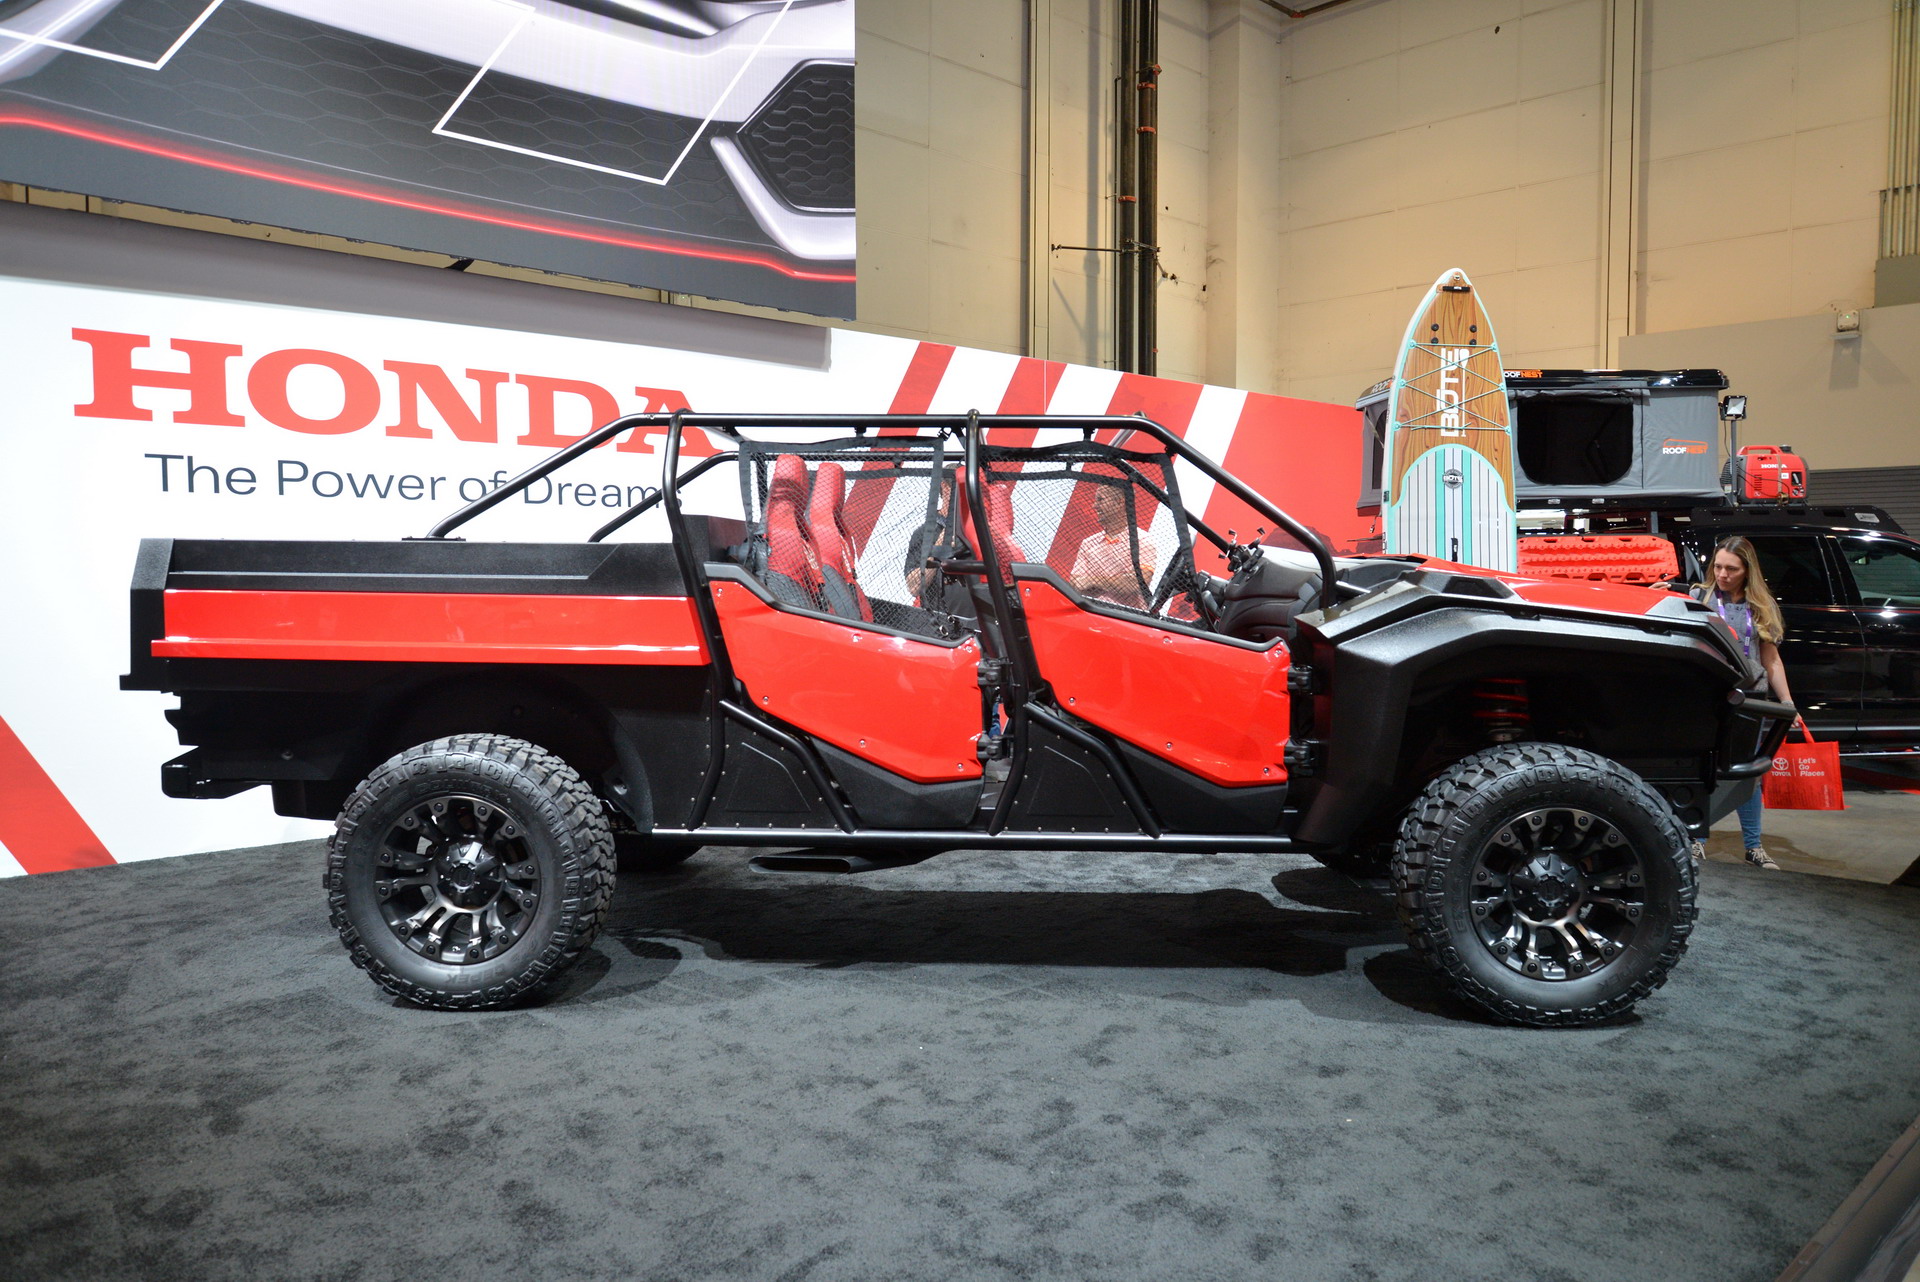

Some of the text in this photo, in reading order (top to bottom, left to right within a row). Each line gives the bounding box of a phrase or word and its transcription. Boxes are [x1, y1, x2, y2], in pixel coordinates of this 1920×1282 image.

[72, 327, 724, 458] HONDA
[1503, 370, 1543, 378] OOFNEST
[144, 453, 257, 495] The
[277, 459, 446, 501] Power
[458, 470, 507, 503] of
